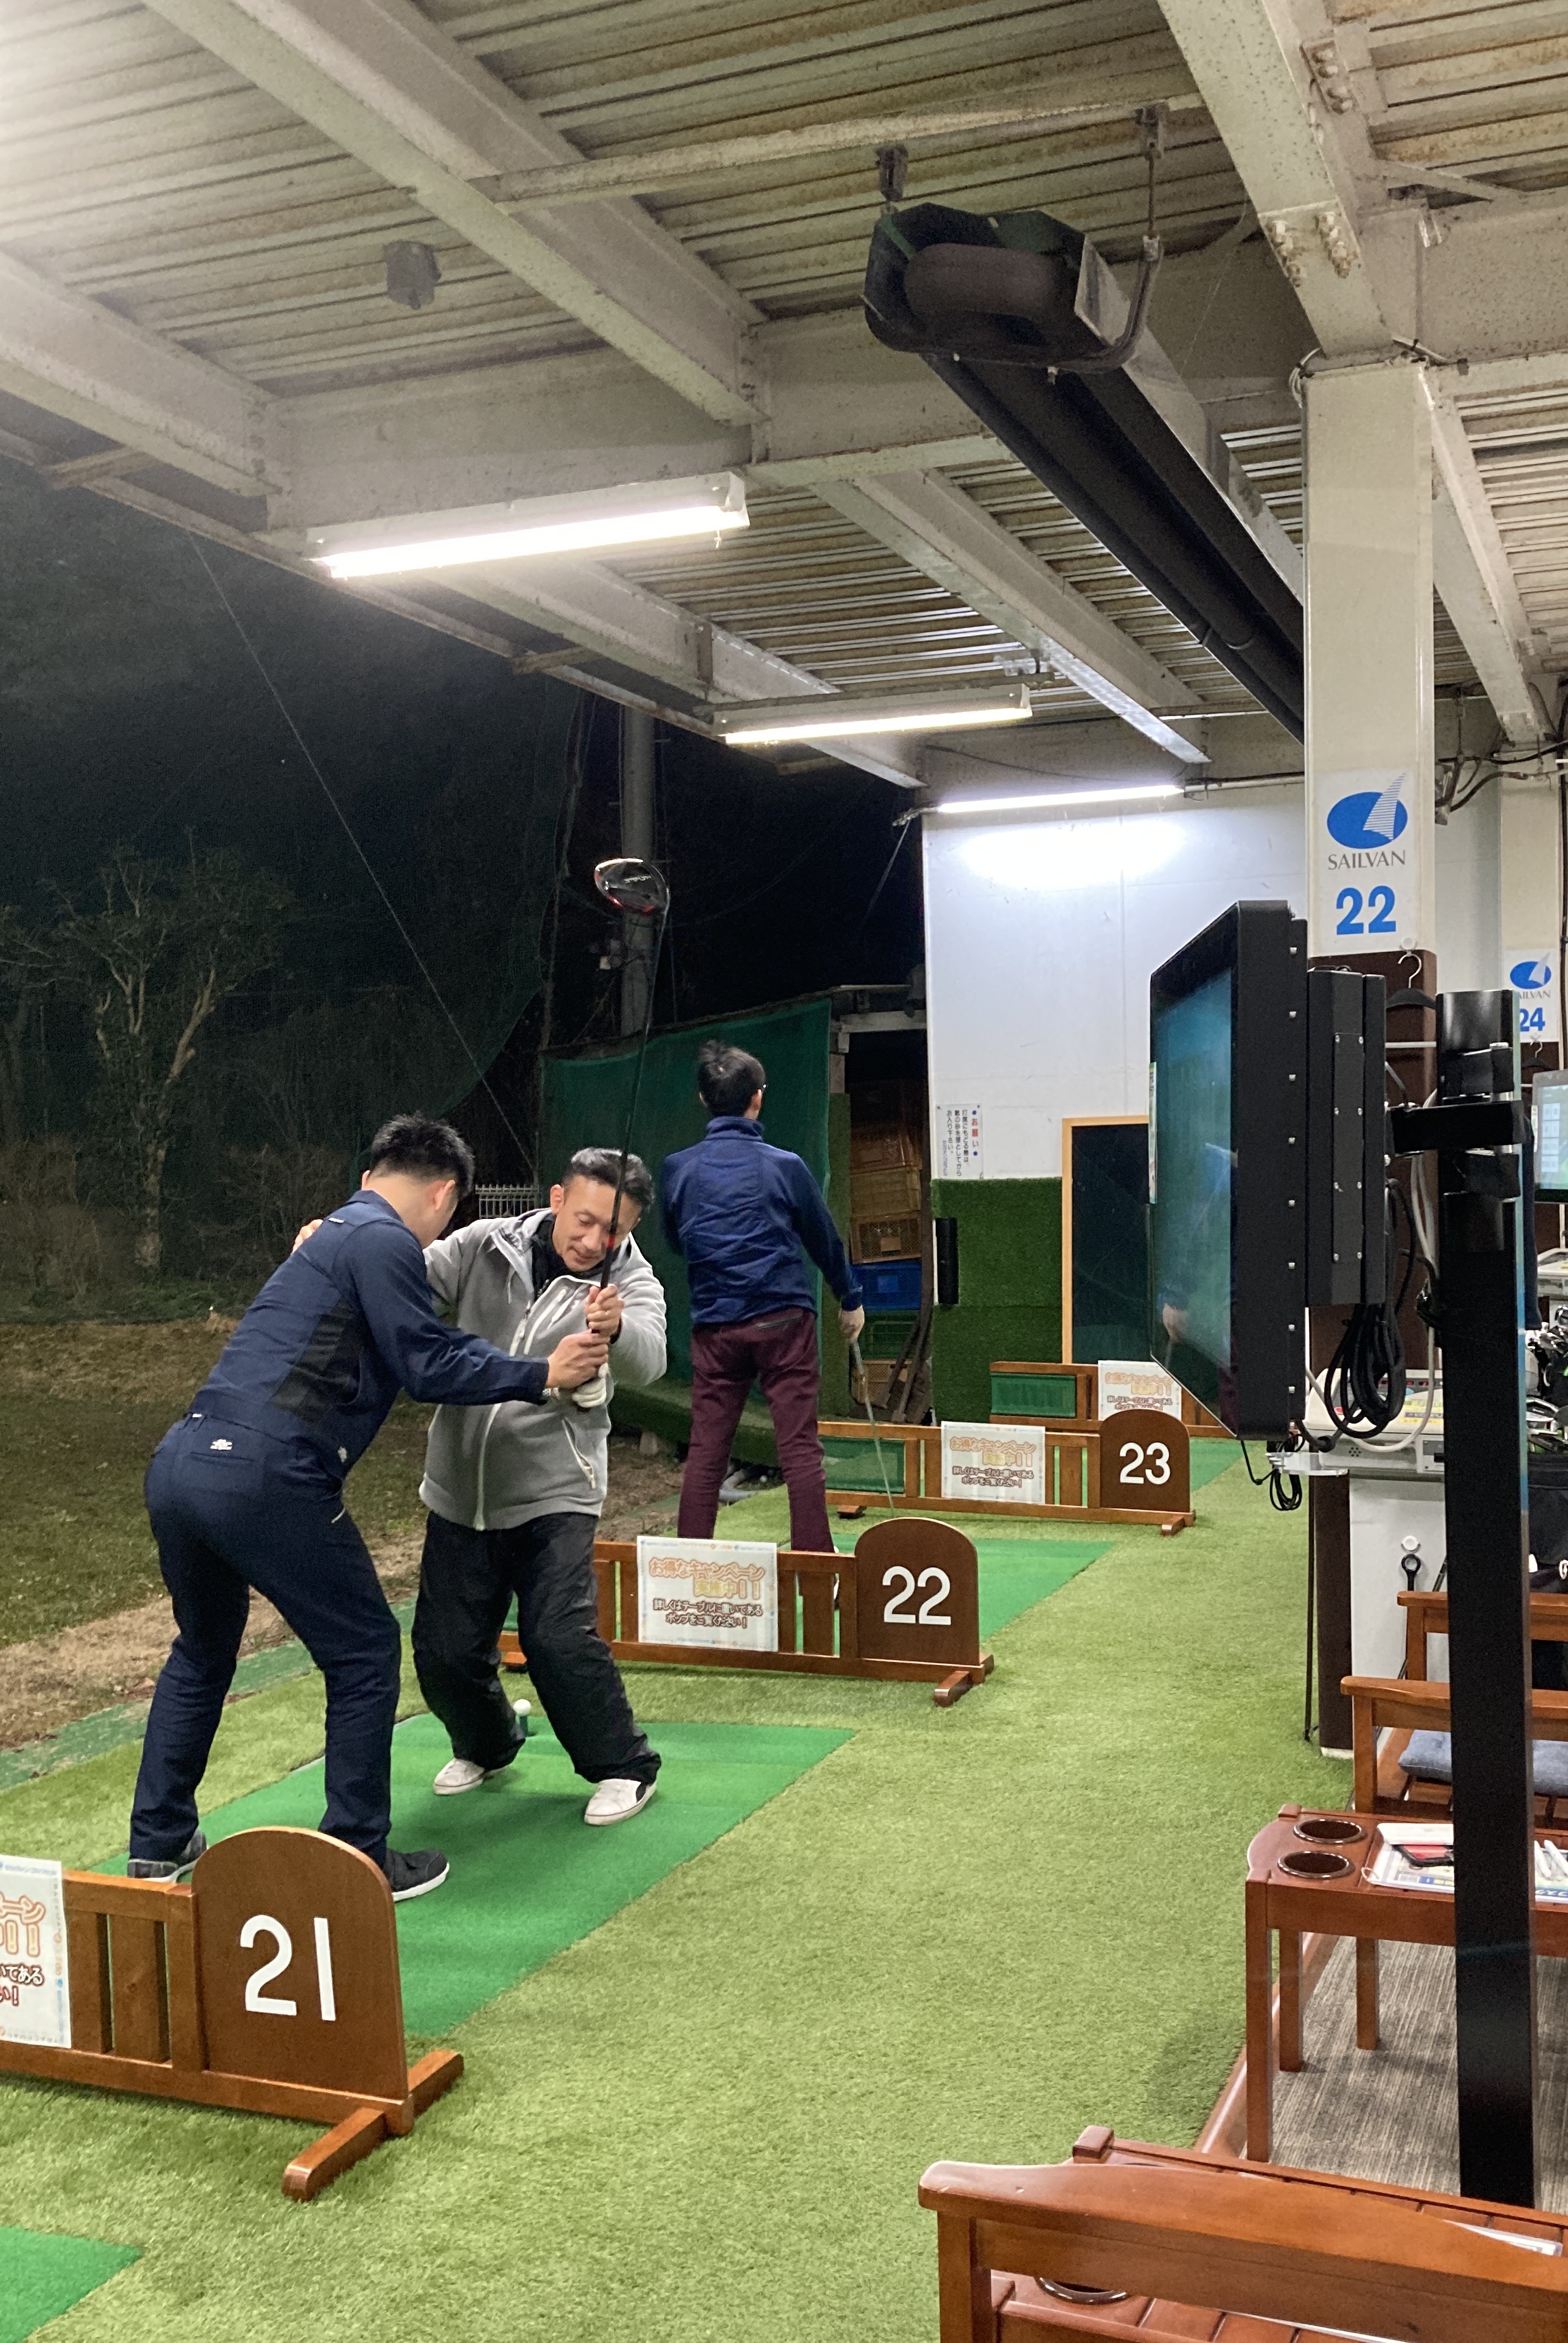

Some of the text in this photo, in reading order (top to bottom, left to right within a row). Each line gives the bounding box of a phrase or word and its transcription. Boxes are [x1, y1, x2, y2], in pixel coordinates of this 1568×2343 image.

[1328, 850, 1405, 870] SAILVAN
[1336, 885, 1396, 935] 22
[1519, 990, 1550, 999] ILVAN
[1519, 1007, 1545, 1032] 24
[950, 1436, 1036, 1454] お得なキャンペーン
[1119, 1442, 1171, 1485] 23
[649, 1557, 766, 1581] お得なキャンペーン
[882, 1566, 951, 1625] 22
[240, 1914, 336, 2021] 21
